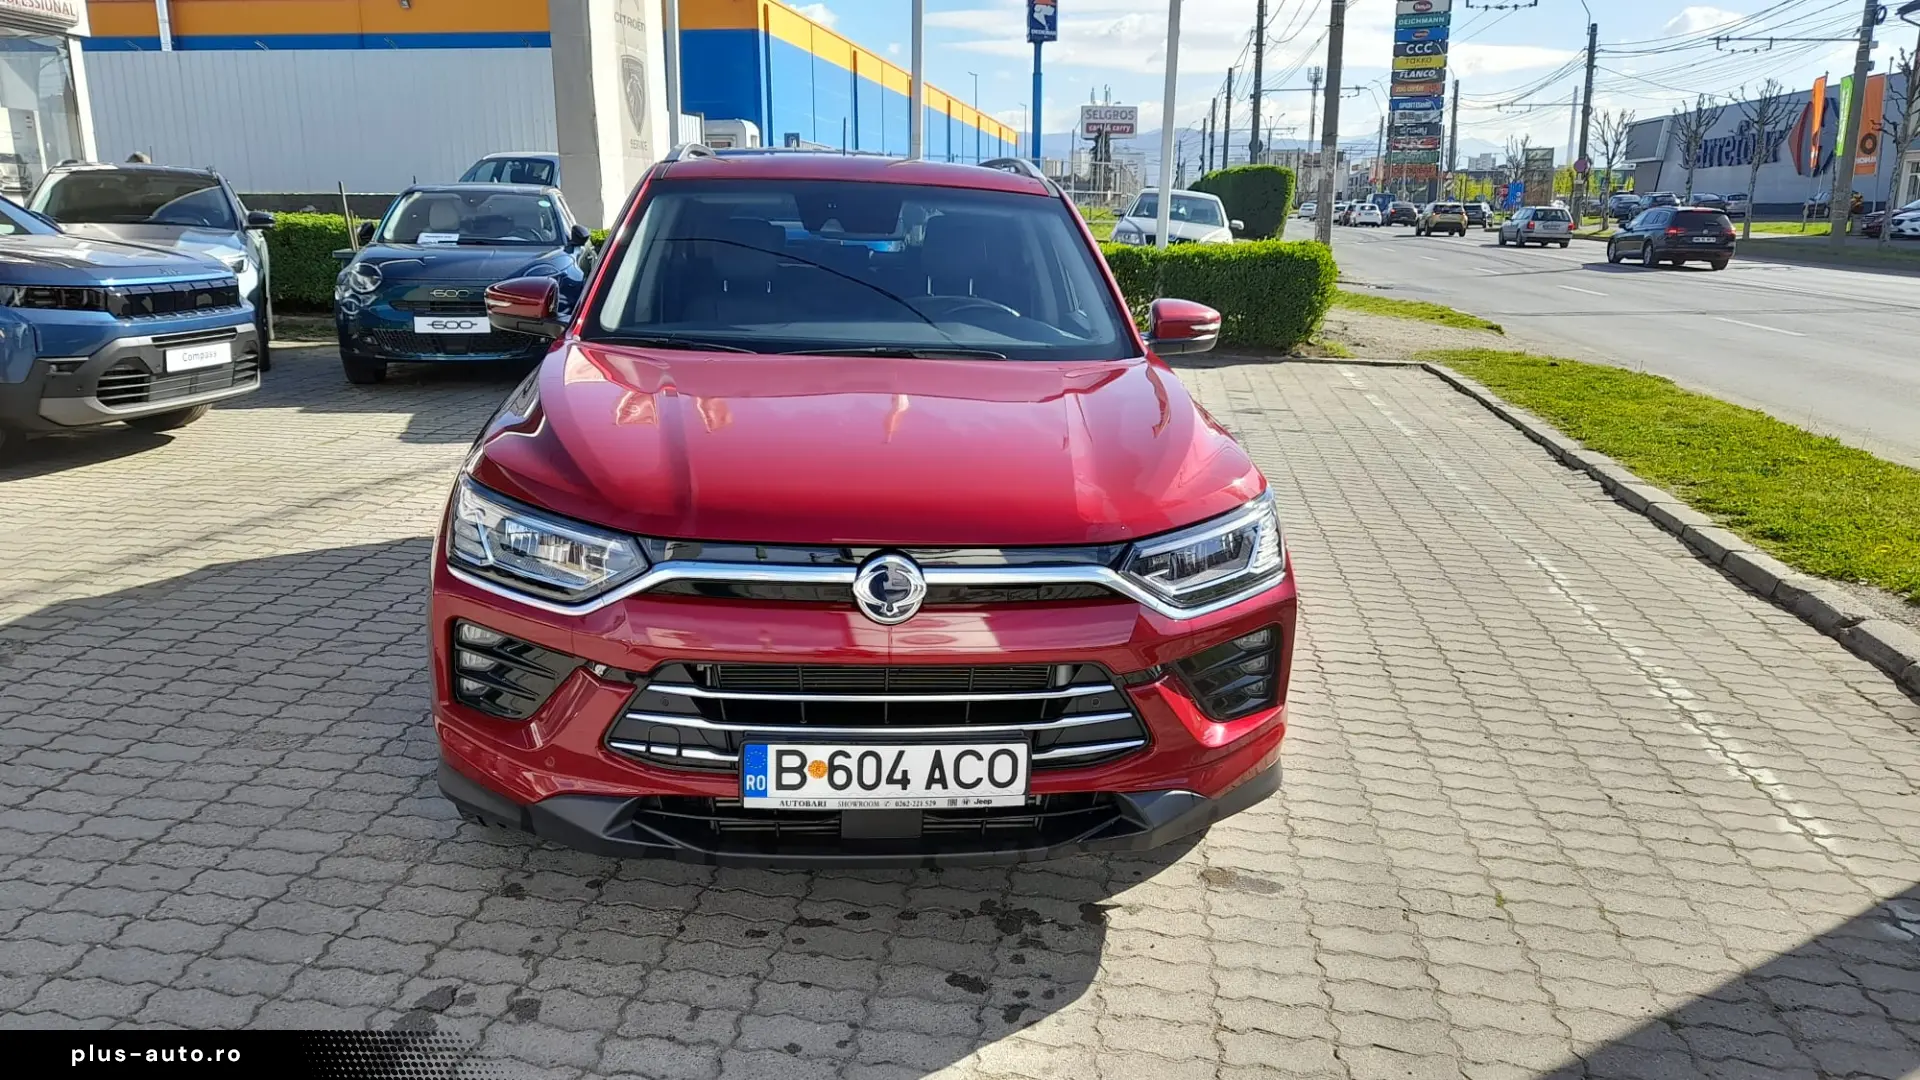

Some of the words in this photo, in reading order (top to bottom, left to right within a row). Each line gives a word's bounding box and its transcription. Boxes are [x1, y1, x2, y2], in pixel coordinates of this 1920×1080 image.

[0, 0, 76, 16] ESSIONAL
[1398, 16, 1445, 25] DEICHMANN
[1406, 42, 1433, 54] CCC
[1400, 70, 1436, 78] FLANCO
[1085, 108, 1134, 120] SELGROS
[432, 289, 471, 298] 600
[430, 320, 475, 330] 600
[182, 351, 217, 362] Compass
[776, 749, 808, 790] B
[827, 750, 911, 790] 604
[925, 748, 1018, 790] ACO
[746, 775, 766, 790] RO
[780, 800, 827, 808] AUTOBARI
[838, 800, 880, 808] SHOWROOM
[974, 798, 992, 806] Jeep
